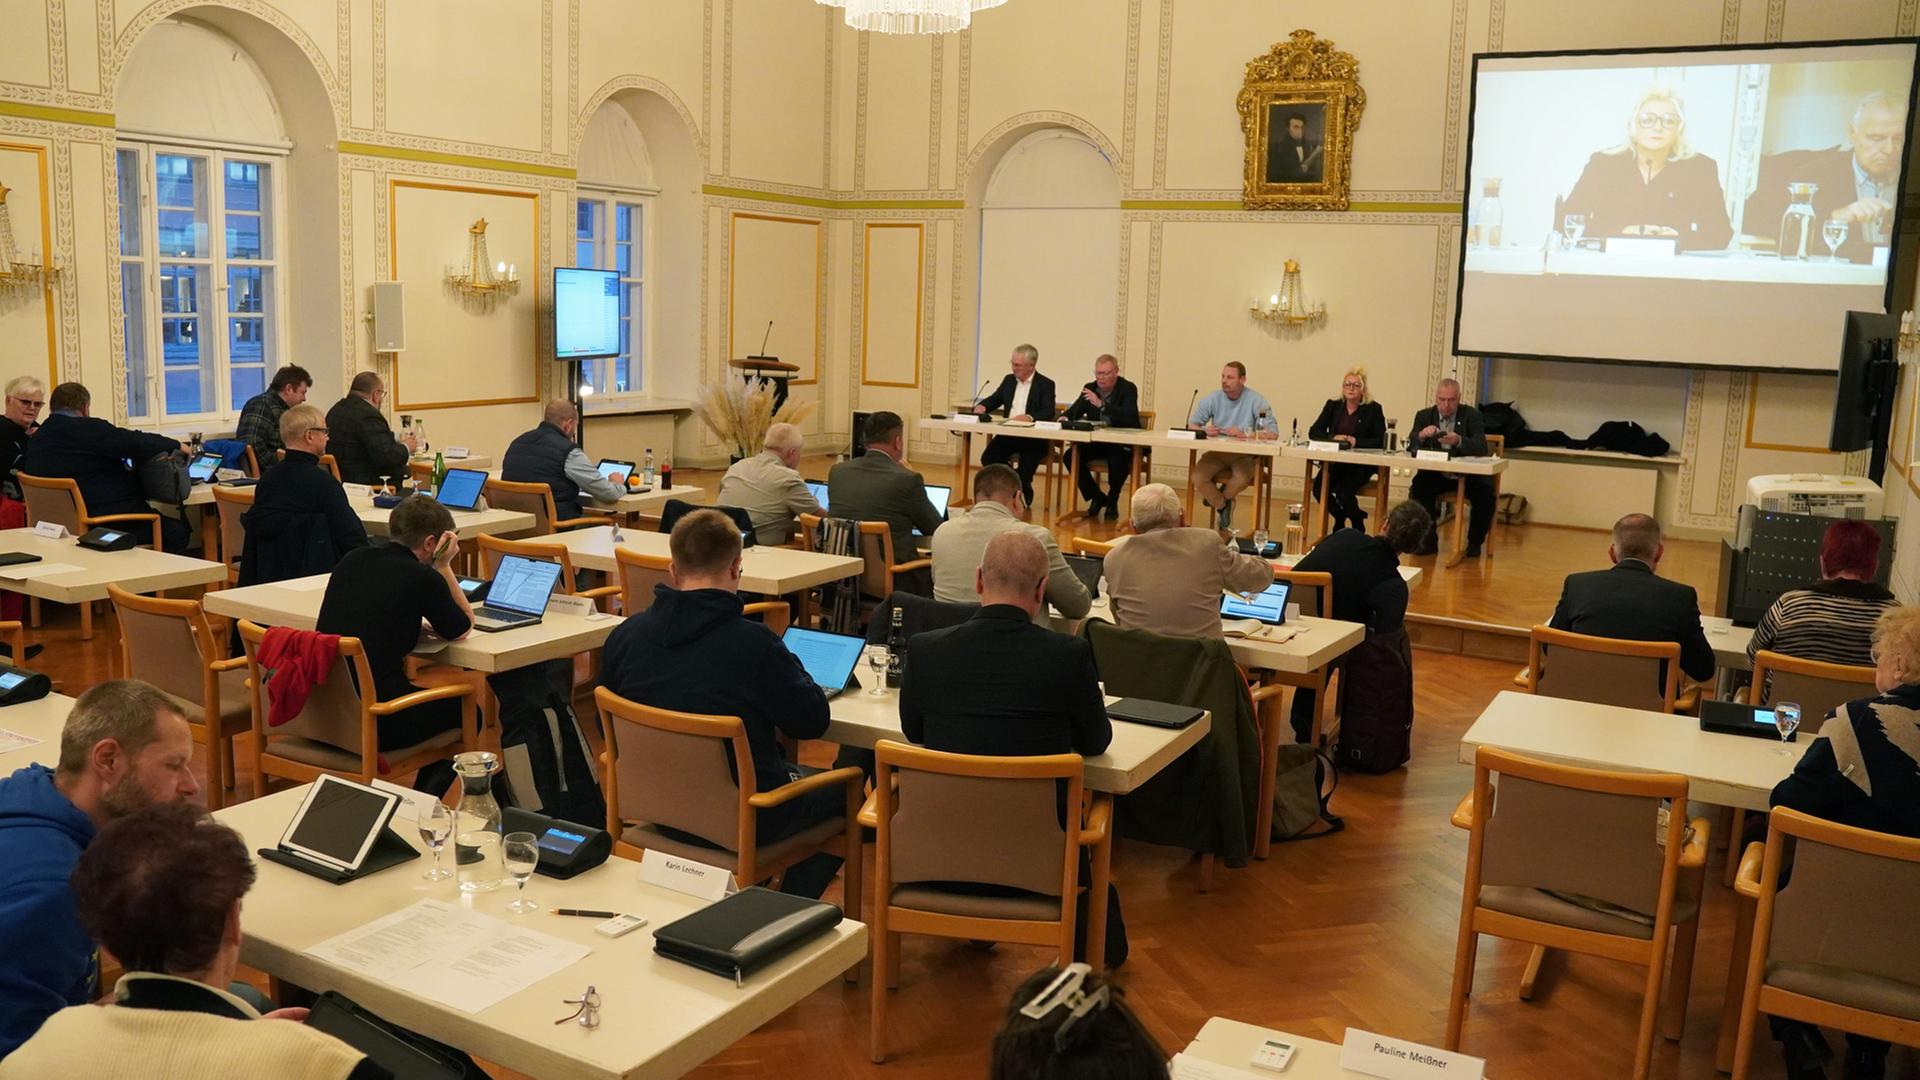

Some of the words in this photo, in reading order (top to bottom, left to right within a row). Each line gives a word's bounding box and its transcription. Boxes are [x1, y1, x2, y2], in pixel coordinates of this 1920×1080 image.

[666, 861, 681, 870] Karin
[682, 864, 705, 877] Lechner
[1374, 1042, 1407, 1059] Pauline
[1409, 1051, 1448, 1069] Meißner
